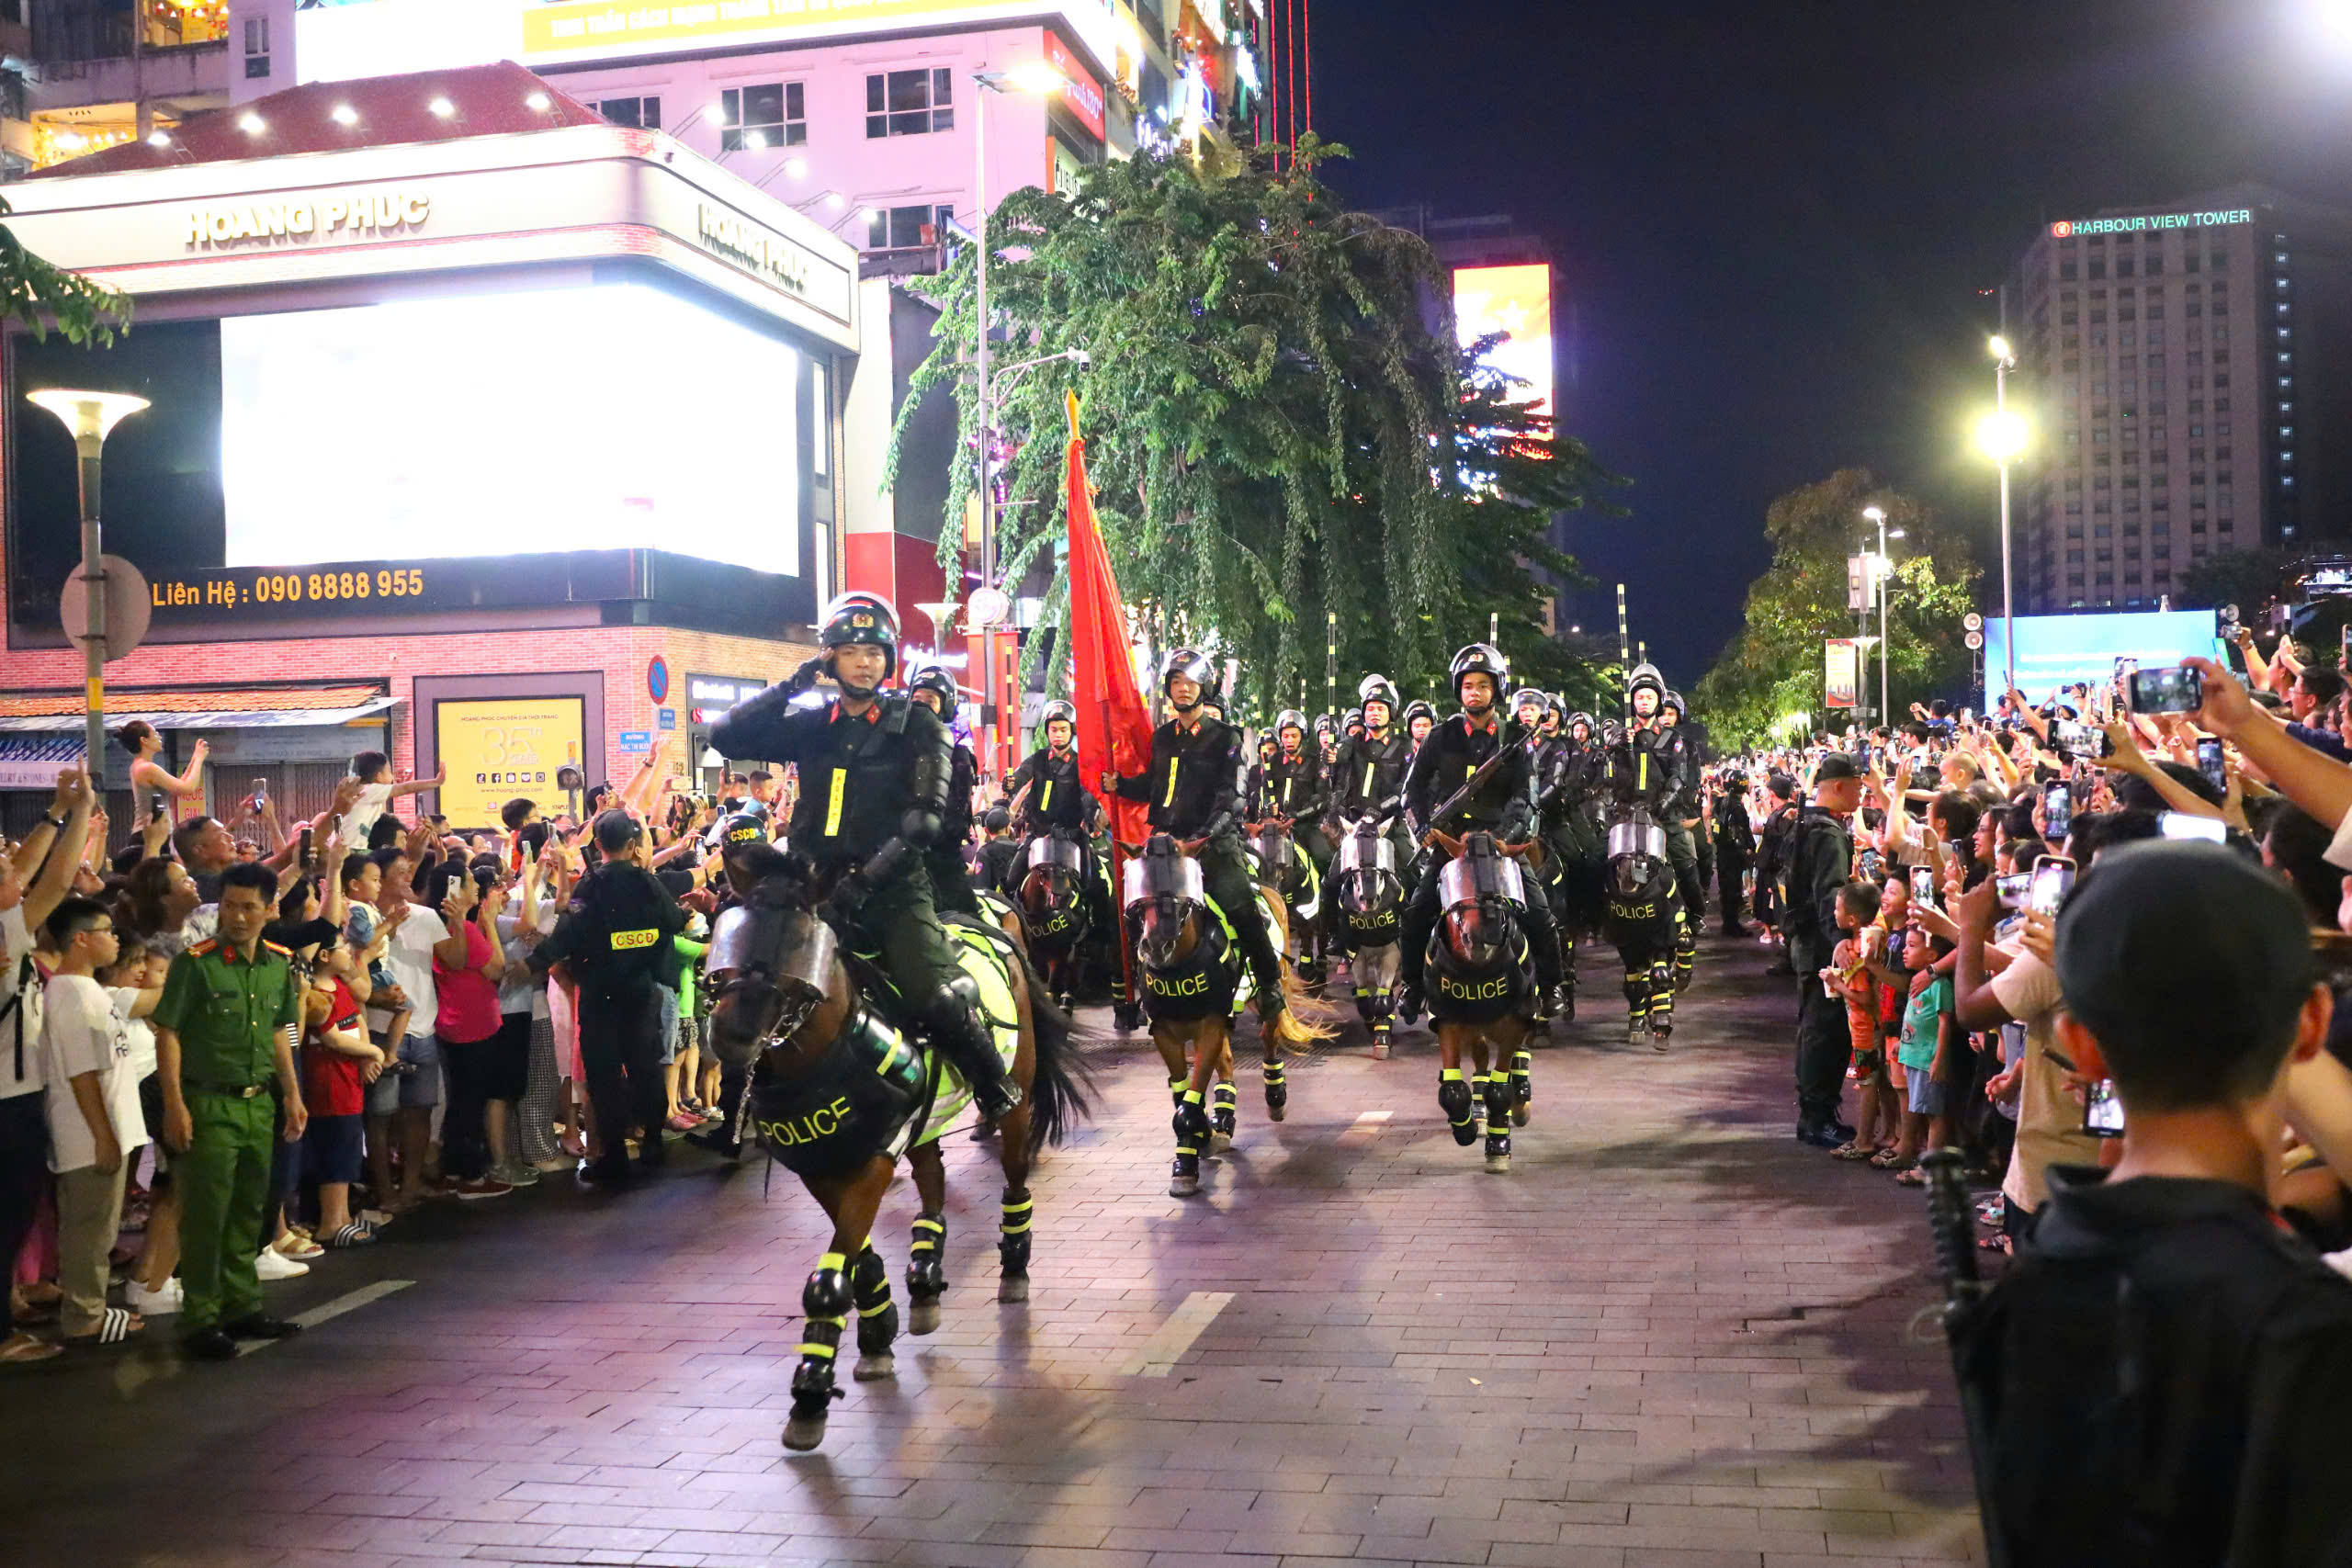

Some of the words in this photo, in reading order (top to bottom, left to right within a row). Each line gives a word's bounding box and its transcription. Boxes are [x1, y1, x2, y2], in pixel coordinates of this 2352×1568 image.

[186, 204, 315, 244] HOANG
[323, 192, 431, 234] PHUC
[2072, 217, 2146, 235] HARBOUR
[2150, 214, 2189, 229] VIEW
[2193, 209, 2251, 226] TOWER
[153, 582, 200, 606] Liên
[207, 581, 237, 609] Hệ
[255, 575, 302, 603] 090
[308, 572, 370, 600] 8888
[377, 570, 424, 597] 955
[1349, 909, 1396, 931] POLICE
[1610, 900, 1656, 919] POLICE
[1146, 972, 1209, 997] POLICE
[1441, 976, 1508, 1000] POLICE
[759, 1096, 851, 1146] POLICE
